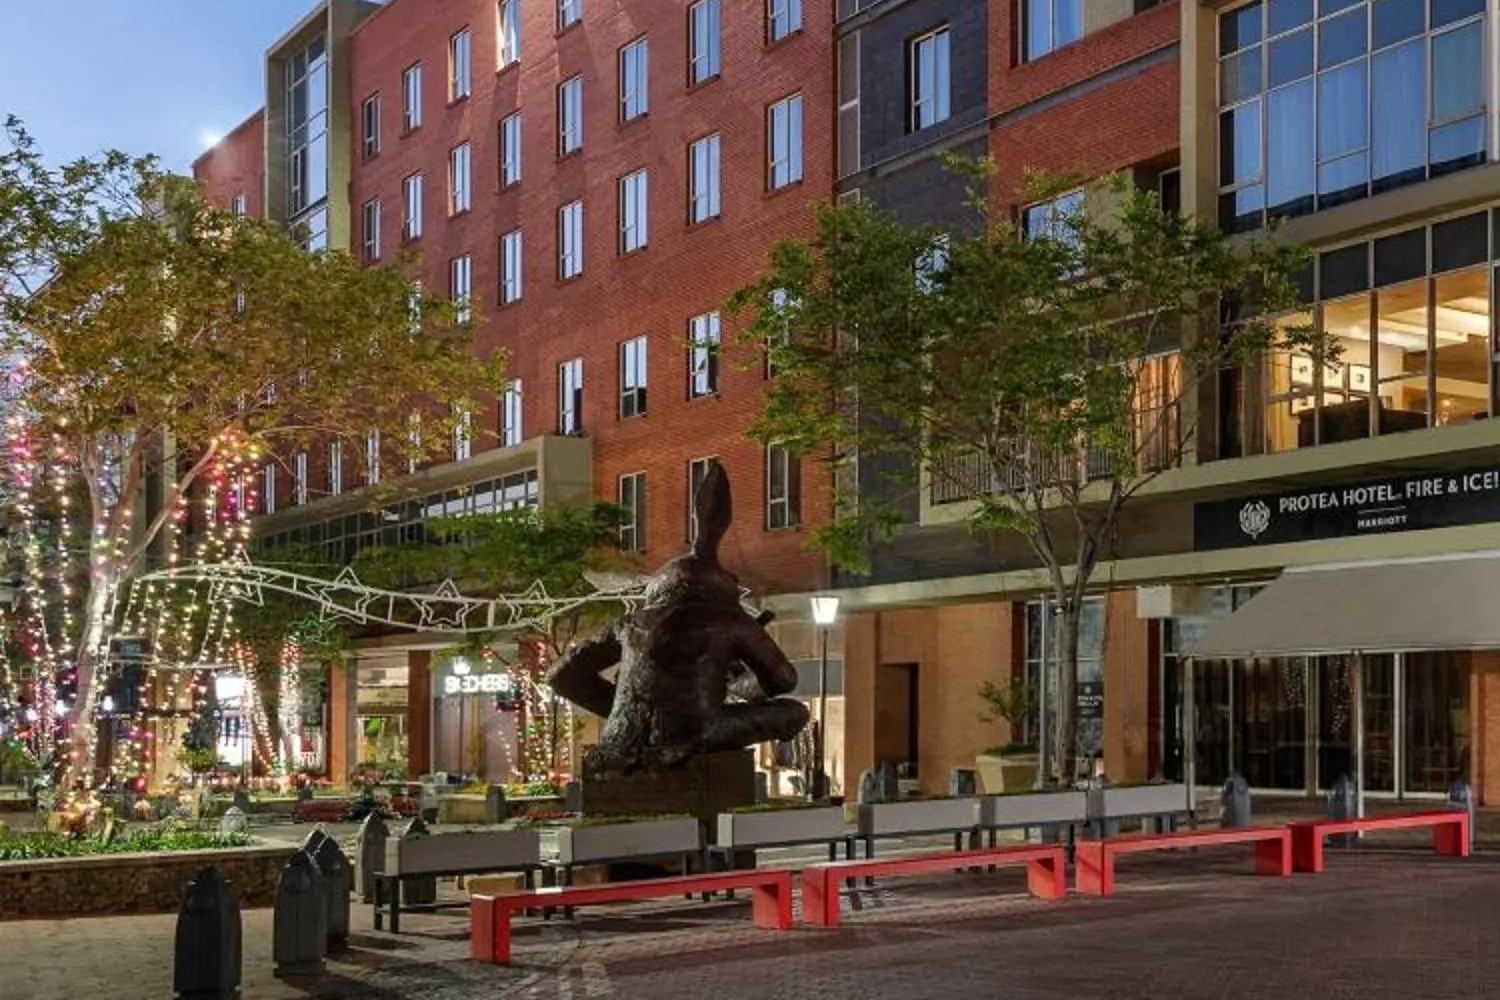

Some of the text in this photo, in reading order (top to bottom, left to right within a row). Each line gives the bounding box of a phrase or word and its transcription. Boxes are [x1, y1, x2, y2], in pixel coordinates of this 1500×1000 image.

[1279, 492, 1340, 513] PROTEA
[1405, 478, 1443, 498] FIRE
[1447, 479, 1459, 493] &
[1463, 471, 1499, 492] ICE!
[1357, 515, 1407, 529] MARRIOTT
